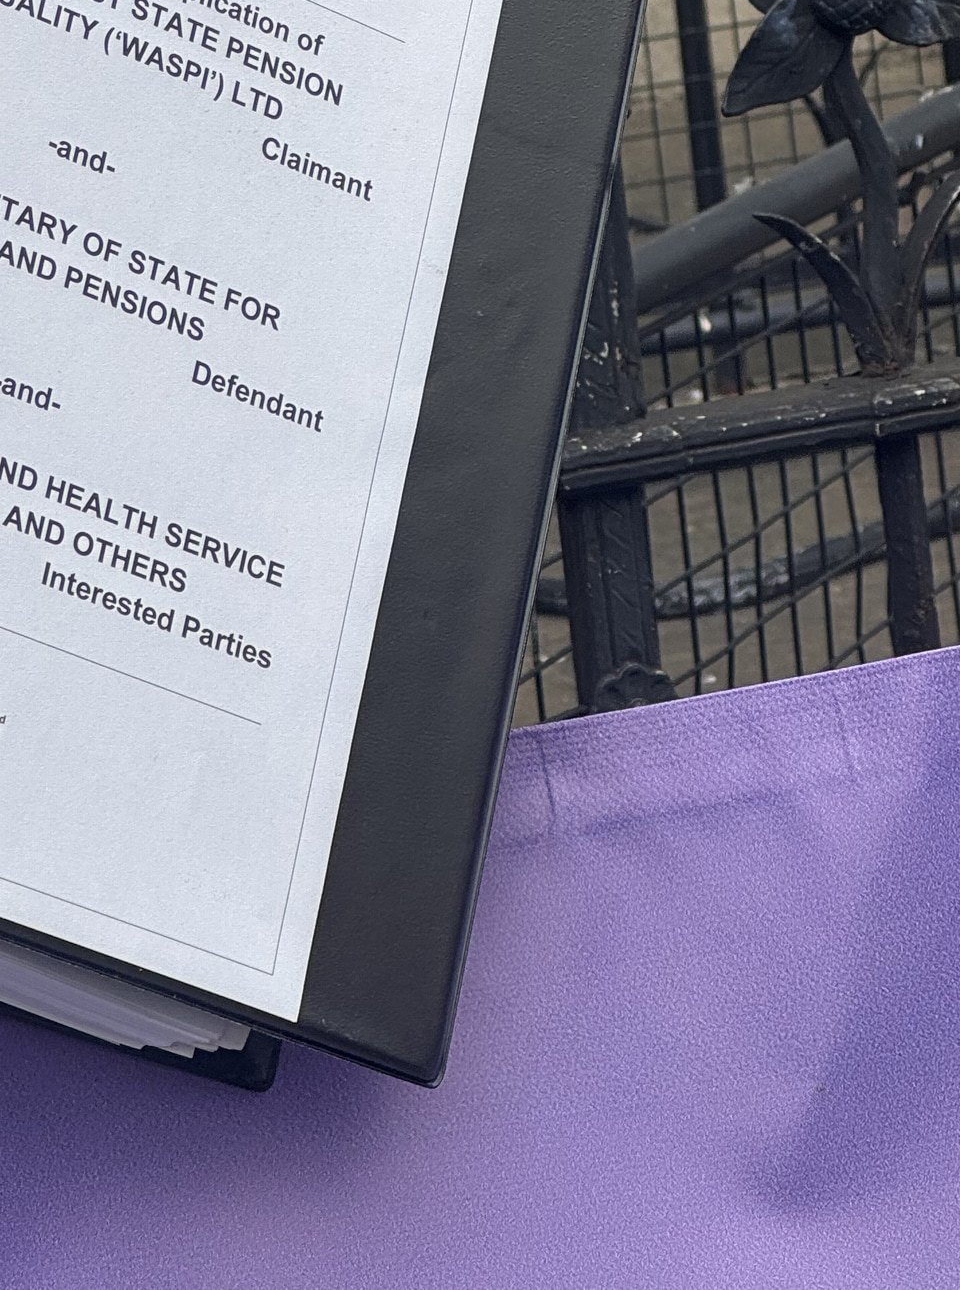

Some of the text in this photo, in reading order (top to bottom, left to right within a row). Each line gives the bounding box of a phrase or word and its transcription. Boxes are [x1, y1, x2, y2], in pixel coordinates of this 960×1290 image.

[225, 35, 344, 107] PENSION
[297, 33, 326, 57] of
[231, 79, 283, 120] LTD
[48, 140, 116, 175] -and-
[261, 137, 373, 202] Claimant
[63, 265, 205, 342] PENSIONS
[82, 231, 123, 262] OF
[127, 249, 218, 305] STATE
[223, 287, 281, 332] FOR
[191, 359, 324, 433] Defendant
[1, 505, 65, 546] AND
[72, 531, 187, 593] OTHERS
[44, 475, 159, 540] HEALTH
[164, 522, 286, 588] SERVICE
[41, 561, 272, 669] Interested Parties
